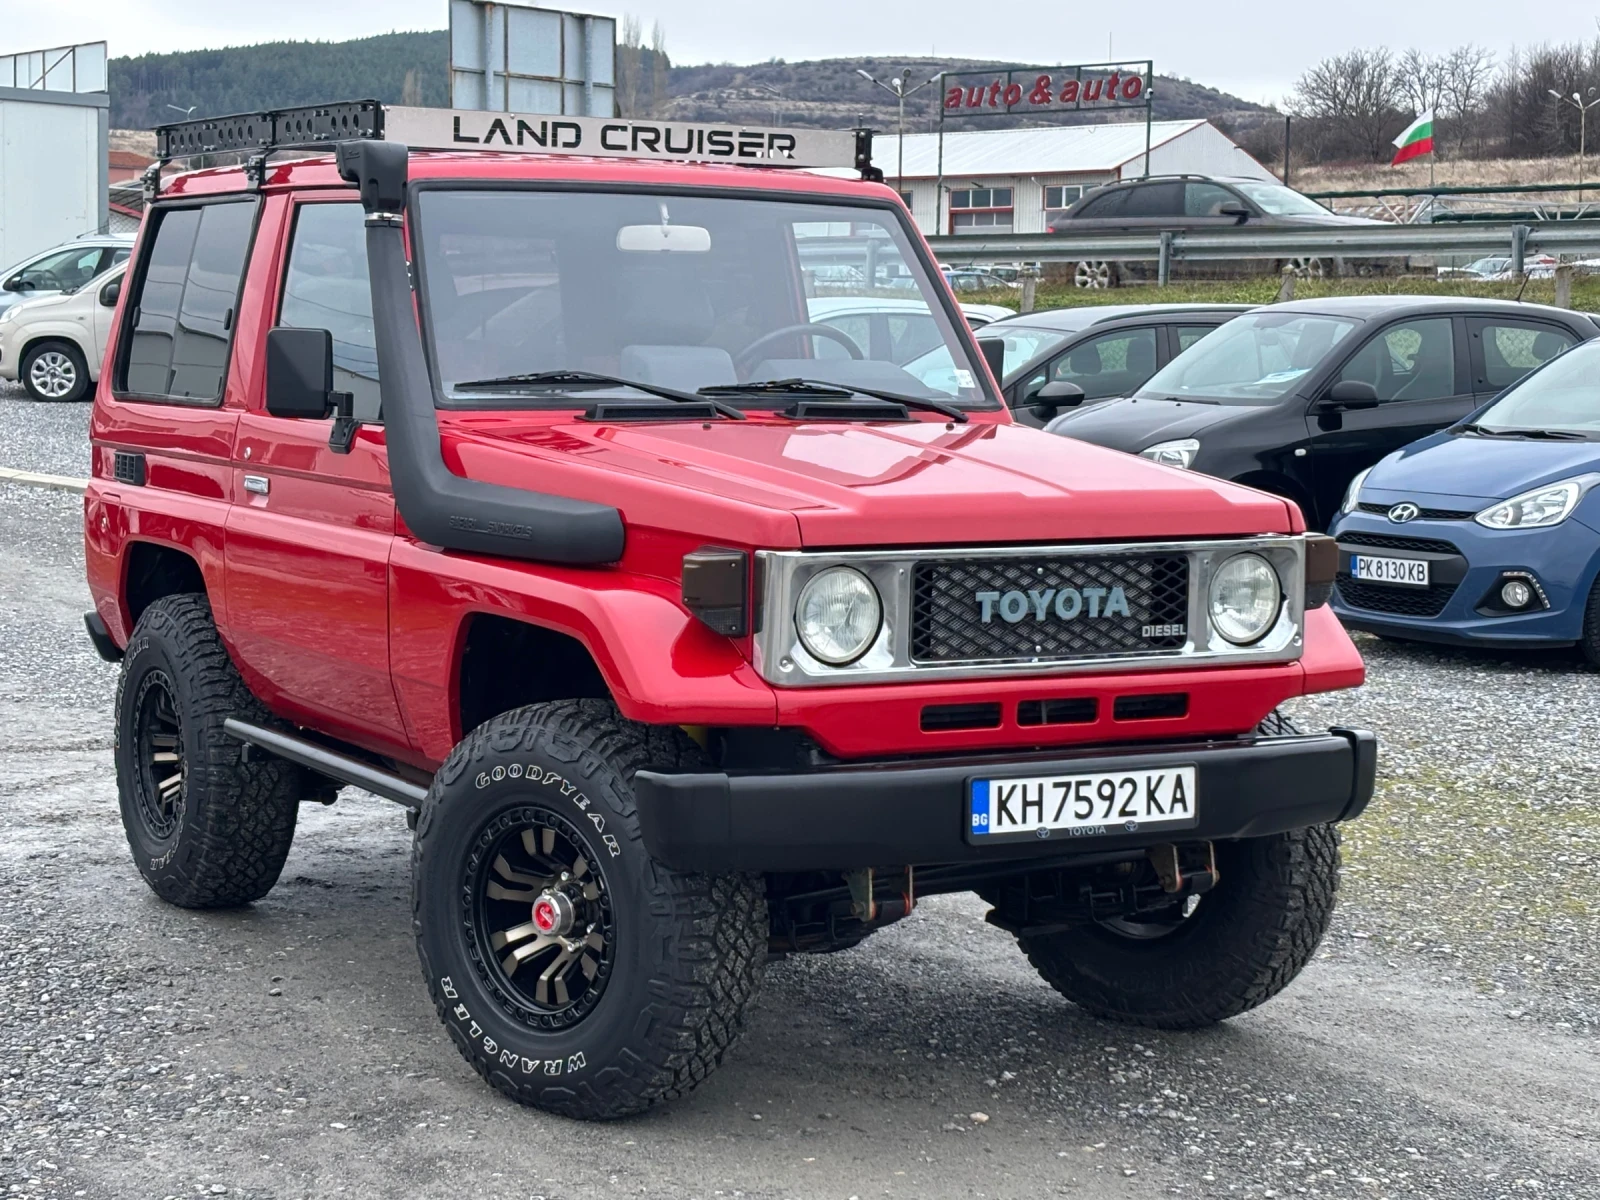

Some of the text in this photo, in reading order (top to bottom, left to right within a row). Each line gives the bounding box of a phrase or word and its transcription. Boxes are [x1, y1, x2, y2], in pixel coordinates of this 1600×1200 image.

[944, 71, 1144, 109] auto & auto
[453, 115, 796, 160] LAND CRUISER
[975, 587, 1131, 624] TOYOTA
[1142, 624, 1187, 638] DIESEL
[474, 763, 621, 858] GOODYEAR
[972, 813, 988, 827] BG
[1067, 825, 1107, 837] TOYOTA
[440, 975, 587, 1076] WRANGLER
